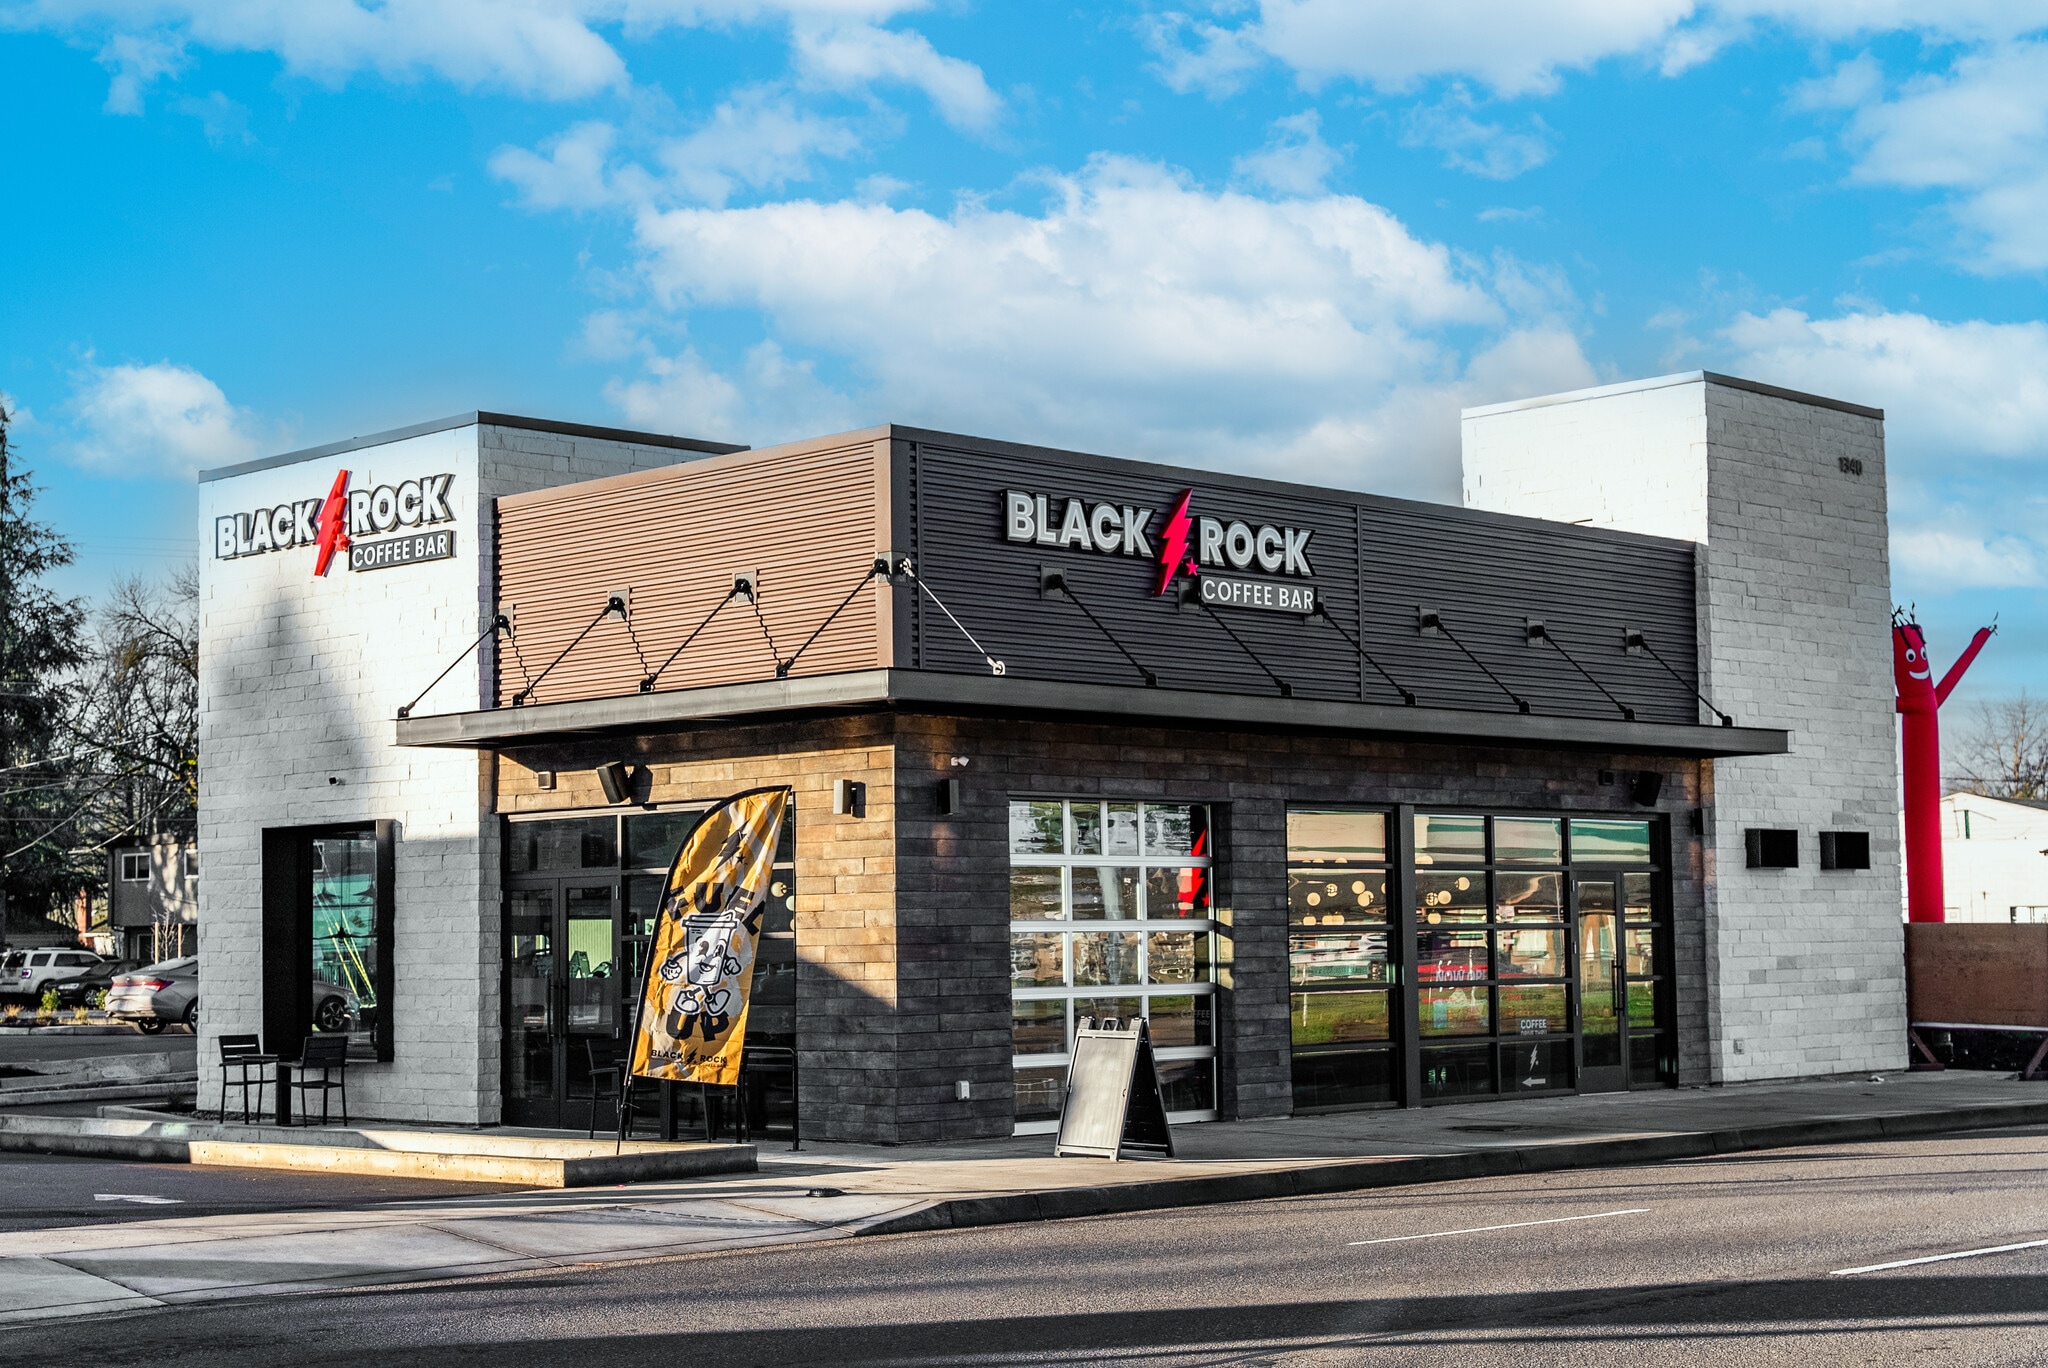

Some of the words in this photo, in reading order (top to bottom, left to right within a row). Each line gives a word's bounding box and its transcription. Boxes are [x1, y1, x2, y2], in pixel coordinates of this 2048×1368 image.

[216, 499, 319, 558] BLACK
[350, 473, 453, 534] ROCK
[1006, 489, 1154, 558] BLACK
[1199, 517, 1312, 576] ROCK
[352, 540, 410, 568] COFFEE
[415, 534, 447, 559] BAR
[1202, 579, 1272, 605] COFFEE
[1278, 588, 1314, 610] BAR
[665, 882, 766, 936] FUEL
[1435, 969, 1464, 982] NOW
[666, 1006, 730, 1042] UP
[1520, 1019, 1547, 1029] COFFEE
[651, 1049, 683, 1060] BLACK
[700, 1054, 728, 1064] ROCK
